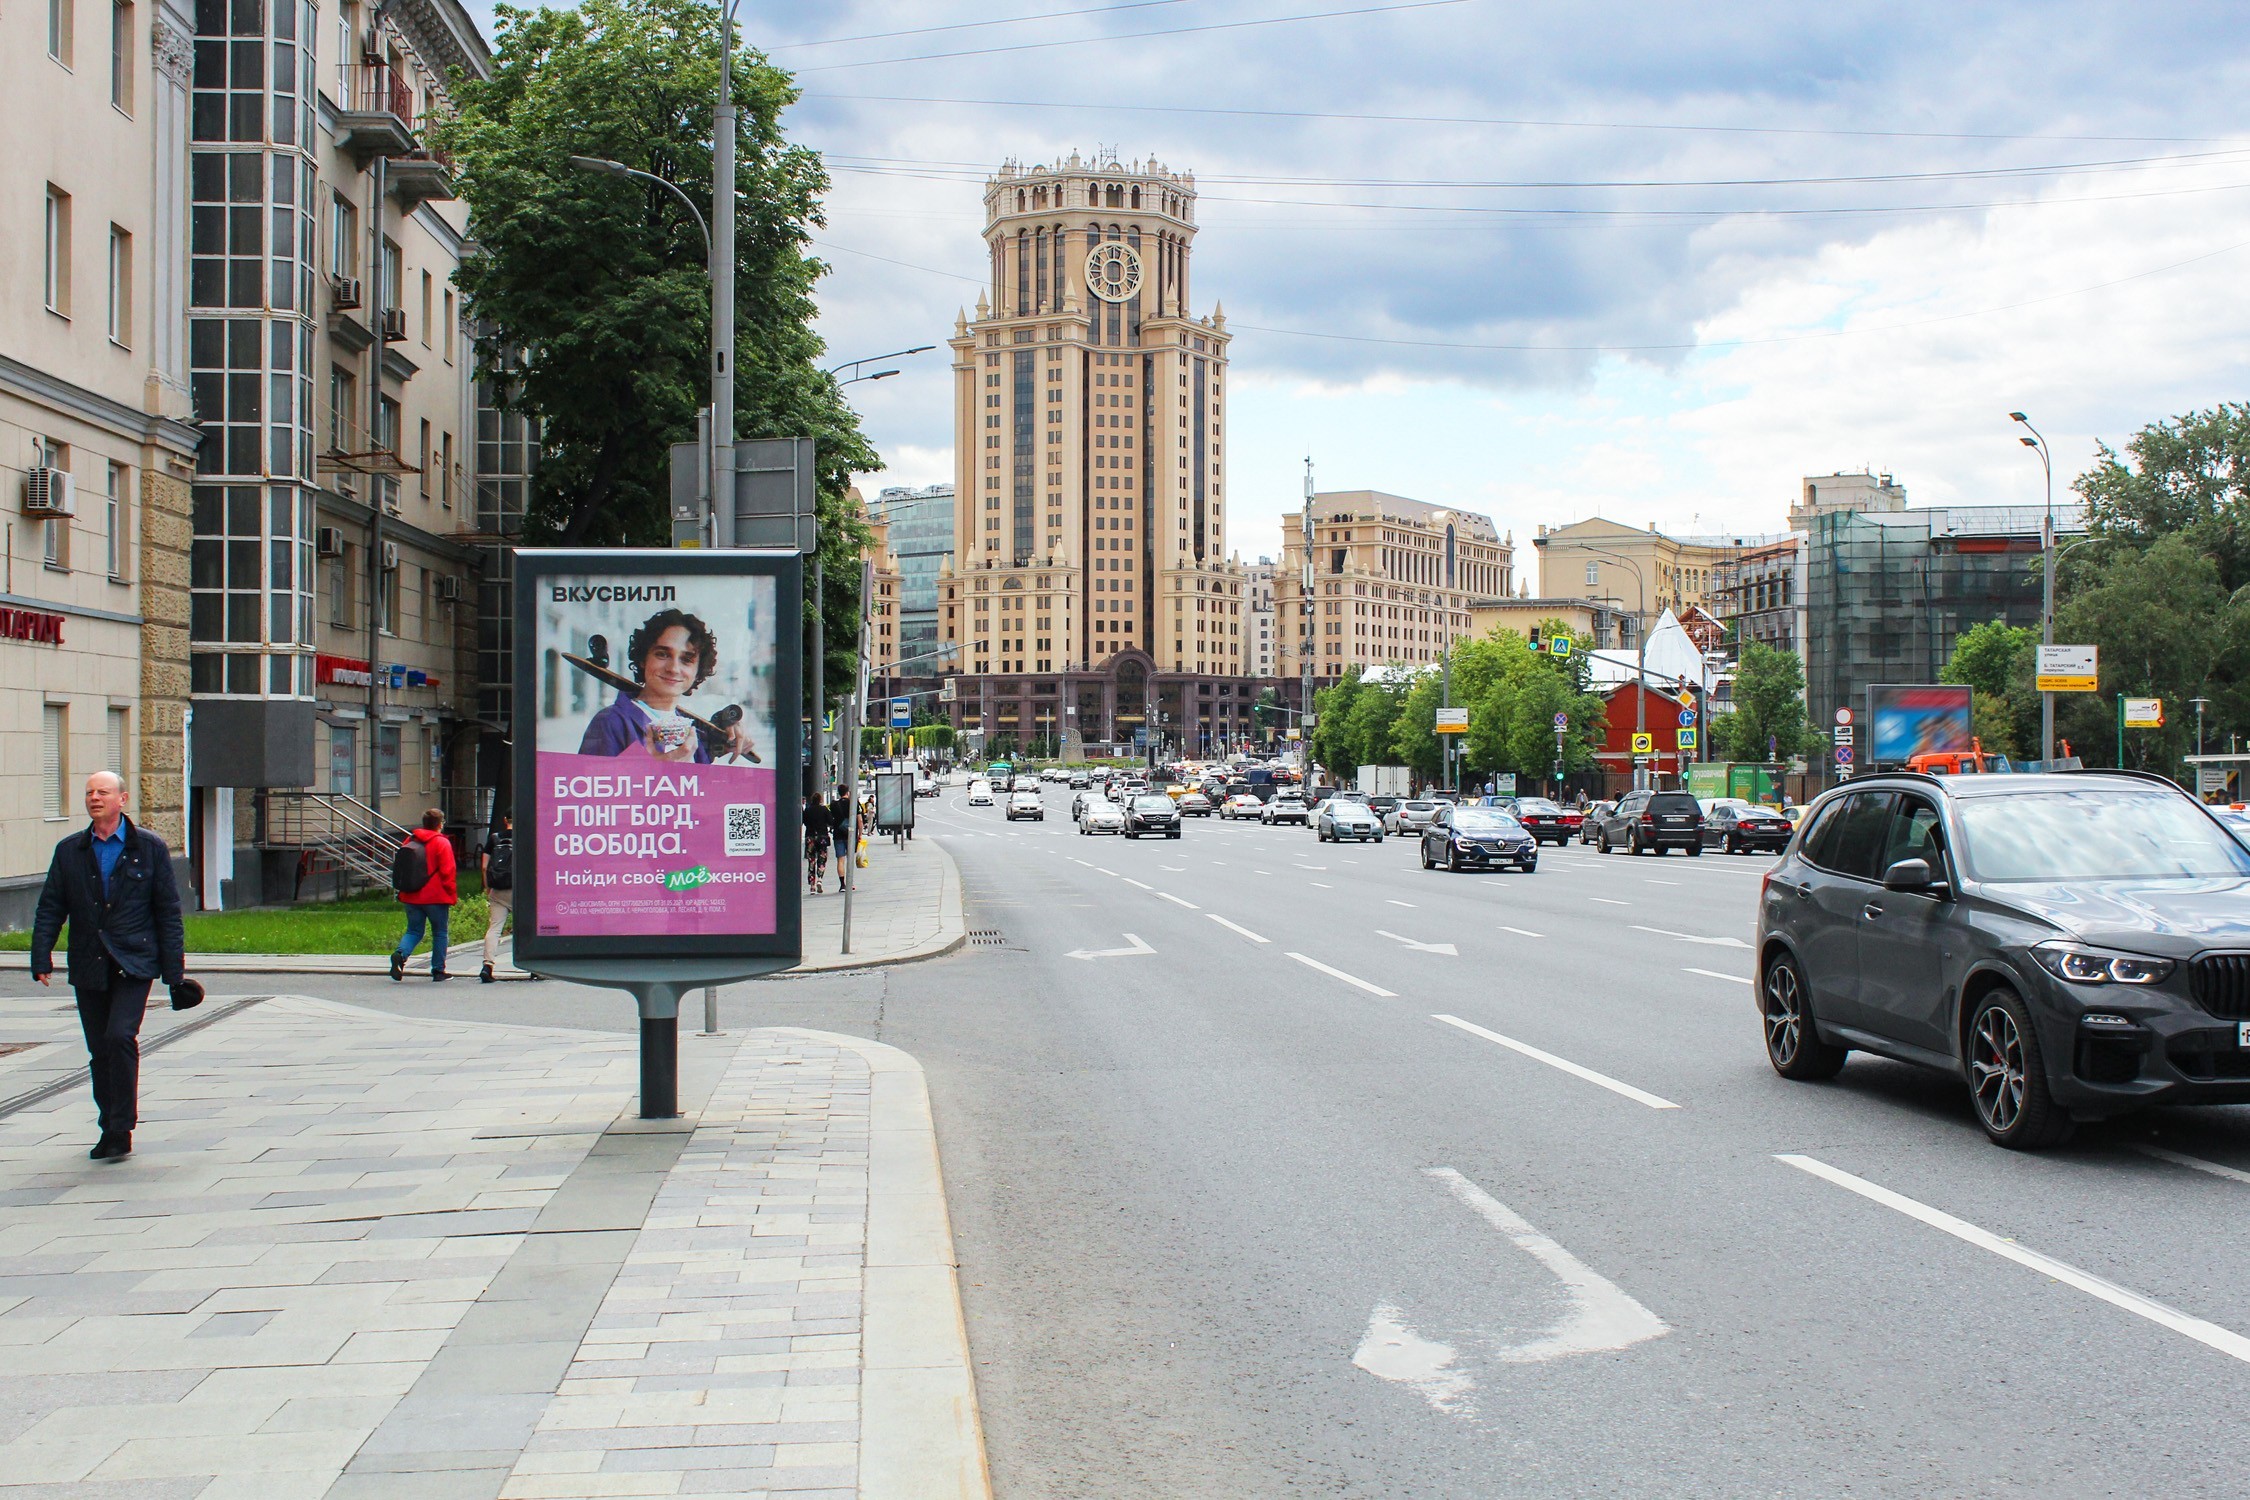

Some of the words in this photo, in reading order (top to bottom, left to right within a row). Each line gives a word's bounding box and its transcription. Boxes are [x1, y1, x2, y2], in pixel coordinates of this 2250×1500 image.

[552, 586, 675, 602] ВКУСВИЛЛ
[553, 804, 700, 829] ЛОНГБОРД.
[555, 870, 617, 887] Найди
[622, 870, 666, 885] своё
